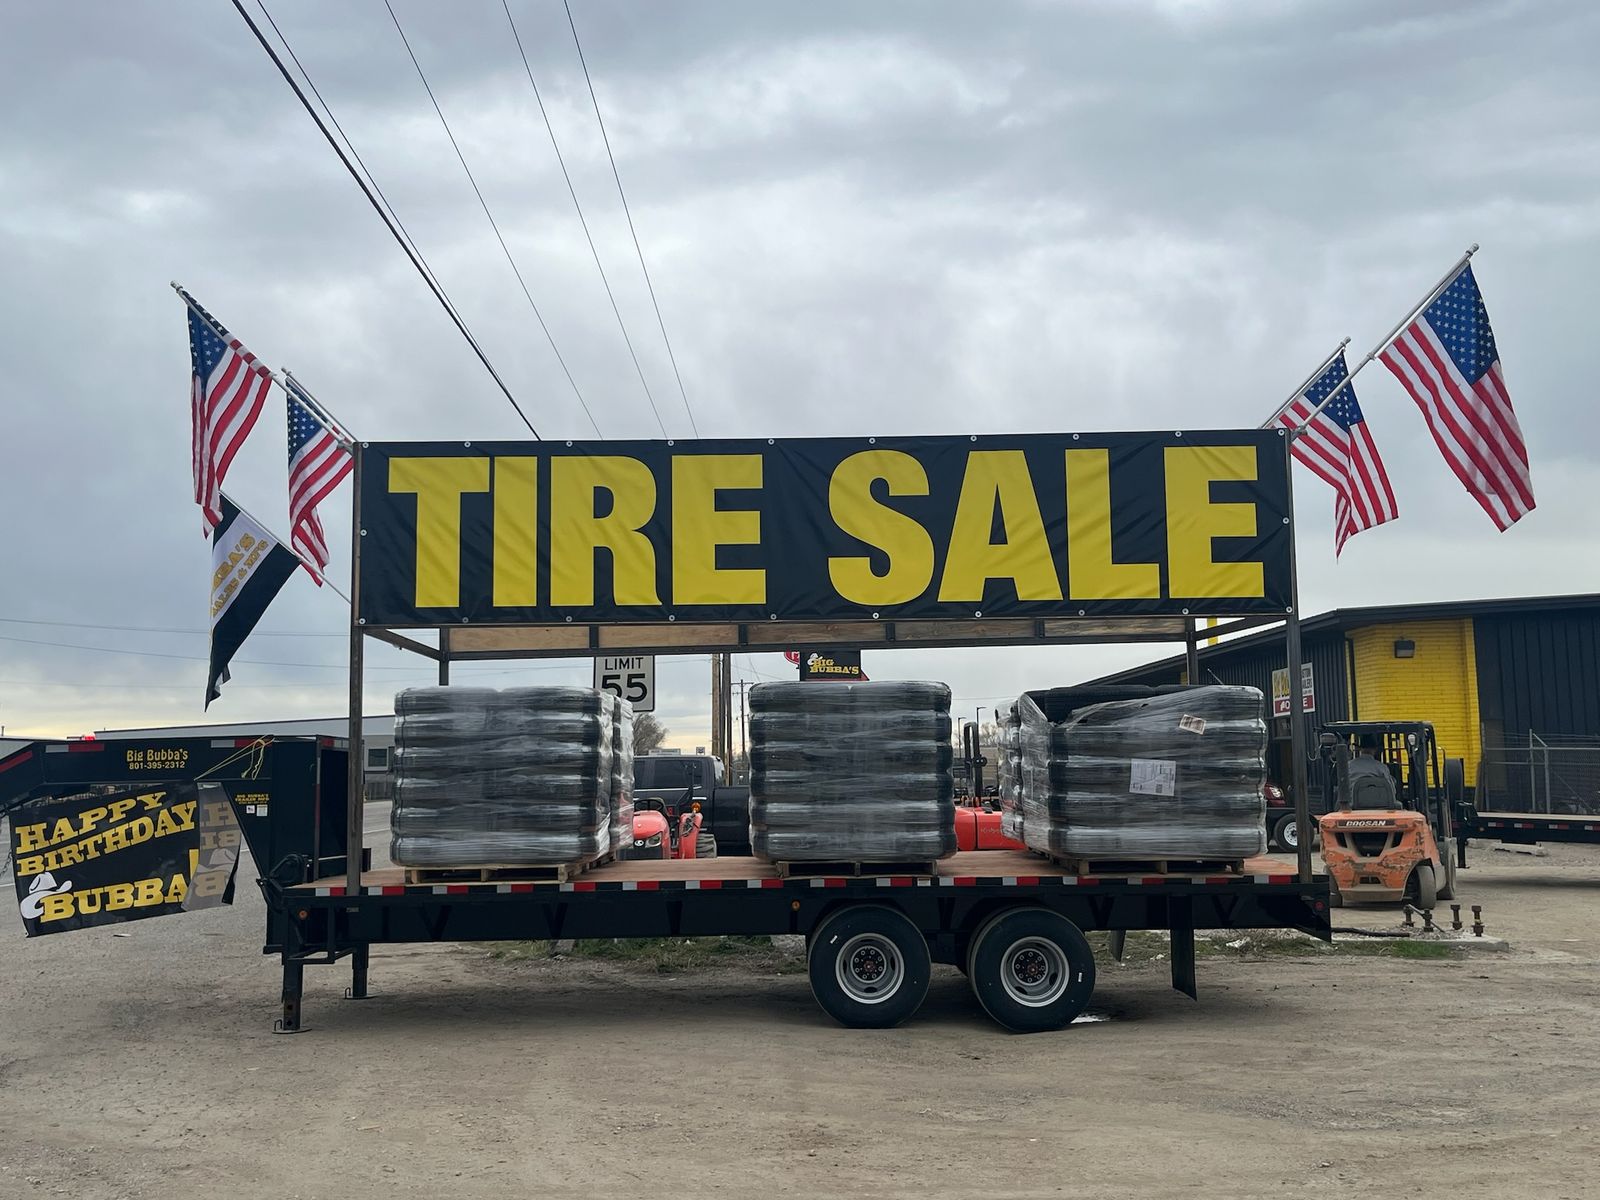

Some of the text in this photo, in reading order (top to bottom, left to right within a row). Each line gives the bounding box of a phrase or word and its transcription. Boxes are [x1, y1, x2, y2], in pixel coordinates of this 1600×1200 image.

[388, 446, 1265, 608] TIRE SALE
[605, 657, 644, 671] LIMIT
[812, 658, 835, 667] BIG
[809, 666, 860, 675] BUBBA'S
[602, 673, 648, 702] 55
[126, 748, 189, 762] Big Bubba's
[129, 760, 186, 770] 801-395-2312
[15, 791, 167, 854] HAPPY
[17, 800, 198, 876] BIRTHDAY
